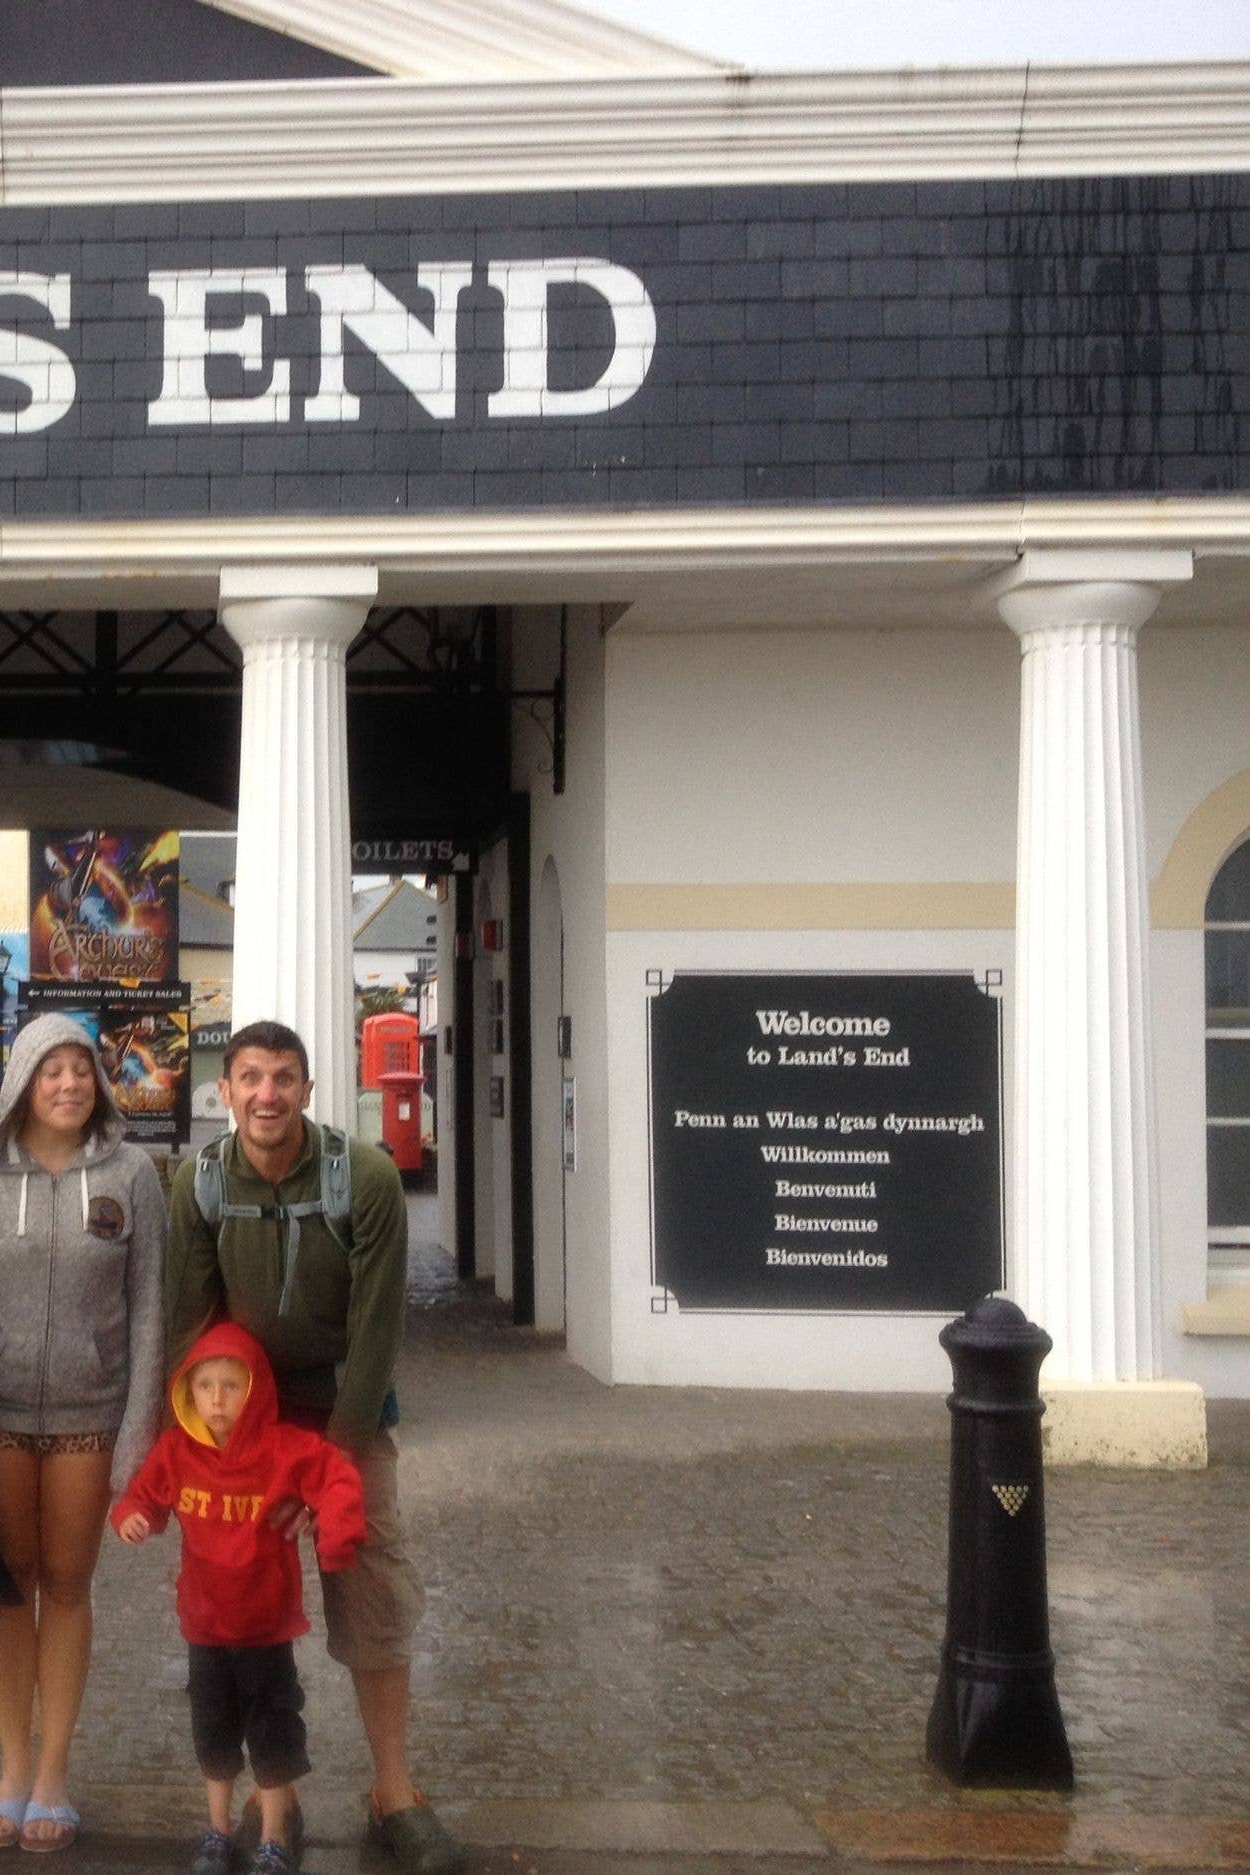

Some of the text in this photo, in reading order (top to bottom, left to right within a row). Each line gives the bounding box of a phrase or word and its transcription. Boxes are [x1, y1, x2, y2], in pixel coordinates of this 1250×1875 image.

[148, 258, 656, 425] END
[352, 841, 453, 860] OILETS
[104, 989, 122, 998] AND
[756, 1011, 890, 1036] Welcome
[197, 1030, 231, 1046] DOU
[747, 1046, 910, 1066] to Land's End
[675, 1111, 726, 1127] Penn
[733, 1115, 759, 1128] an
[766, 1112, 818, 1128] Wlas
[761, 1146, 890, 1163] Willkommen
[776, 1180, 876, 1198] Benvenuti
[775, 1215, 878, 1232] Bienvenue
[766, 1249, 887, 1266] Bienvenidos
[178, 1487, 212, 1518] ST
